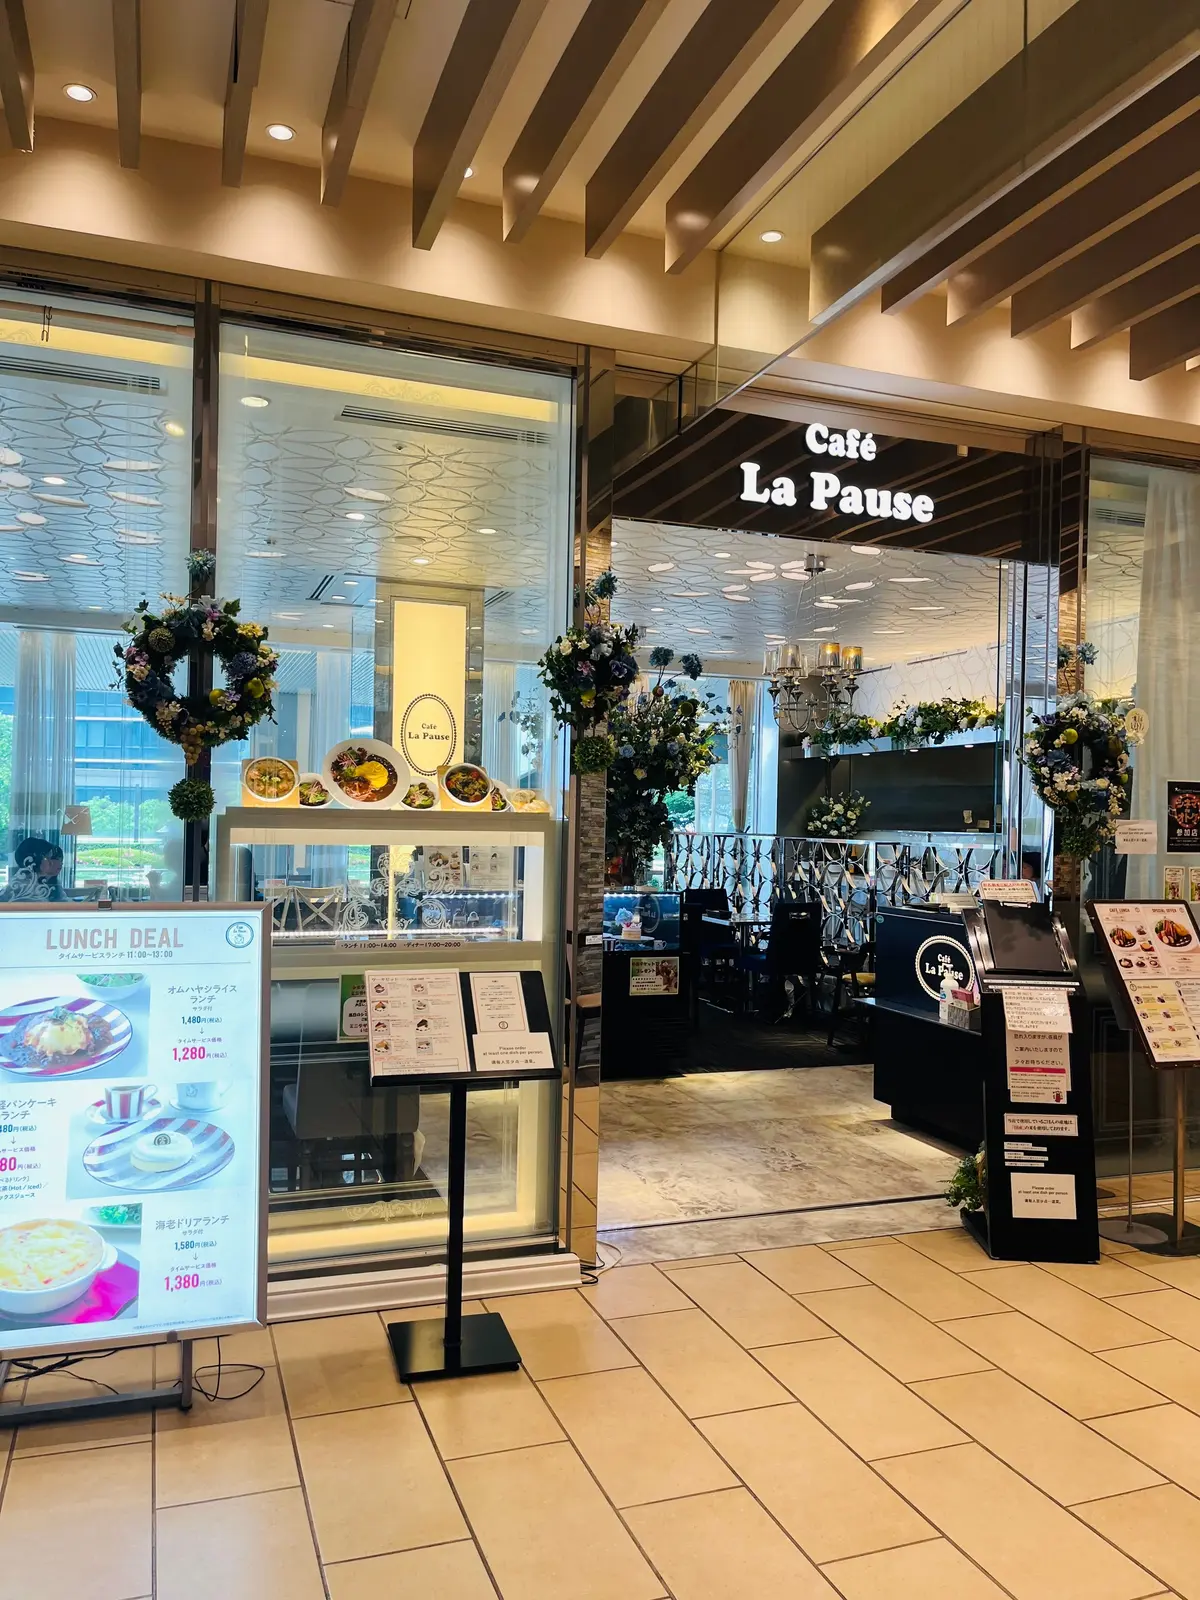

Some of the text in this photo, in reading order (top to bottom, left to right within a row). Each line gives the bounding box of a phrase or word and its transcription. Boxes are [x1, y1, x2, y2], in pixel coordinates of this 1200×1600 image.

[805, 423, 877, 462] Café
[740, 462, 935, 523] La Pause
[423, 733, 450, 741] Pause
[1177, 829, 1198, 837] 参加店
[46, 927, 184, 949] LUNCH DEAL
[58, 951, 125, 960] タイムサービスランチ
[925, 963, 936, 975] La
[167, 984, 237, 994] オムハヤシライス
[190, 995, 216, 1004] ランチ
[0, 1110, 30, 1120] ランチ
[155, 1214, 229, 1230] 海老ドリアランチ
